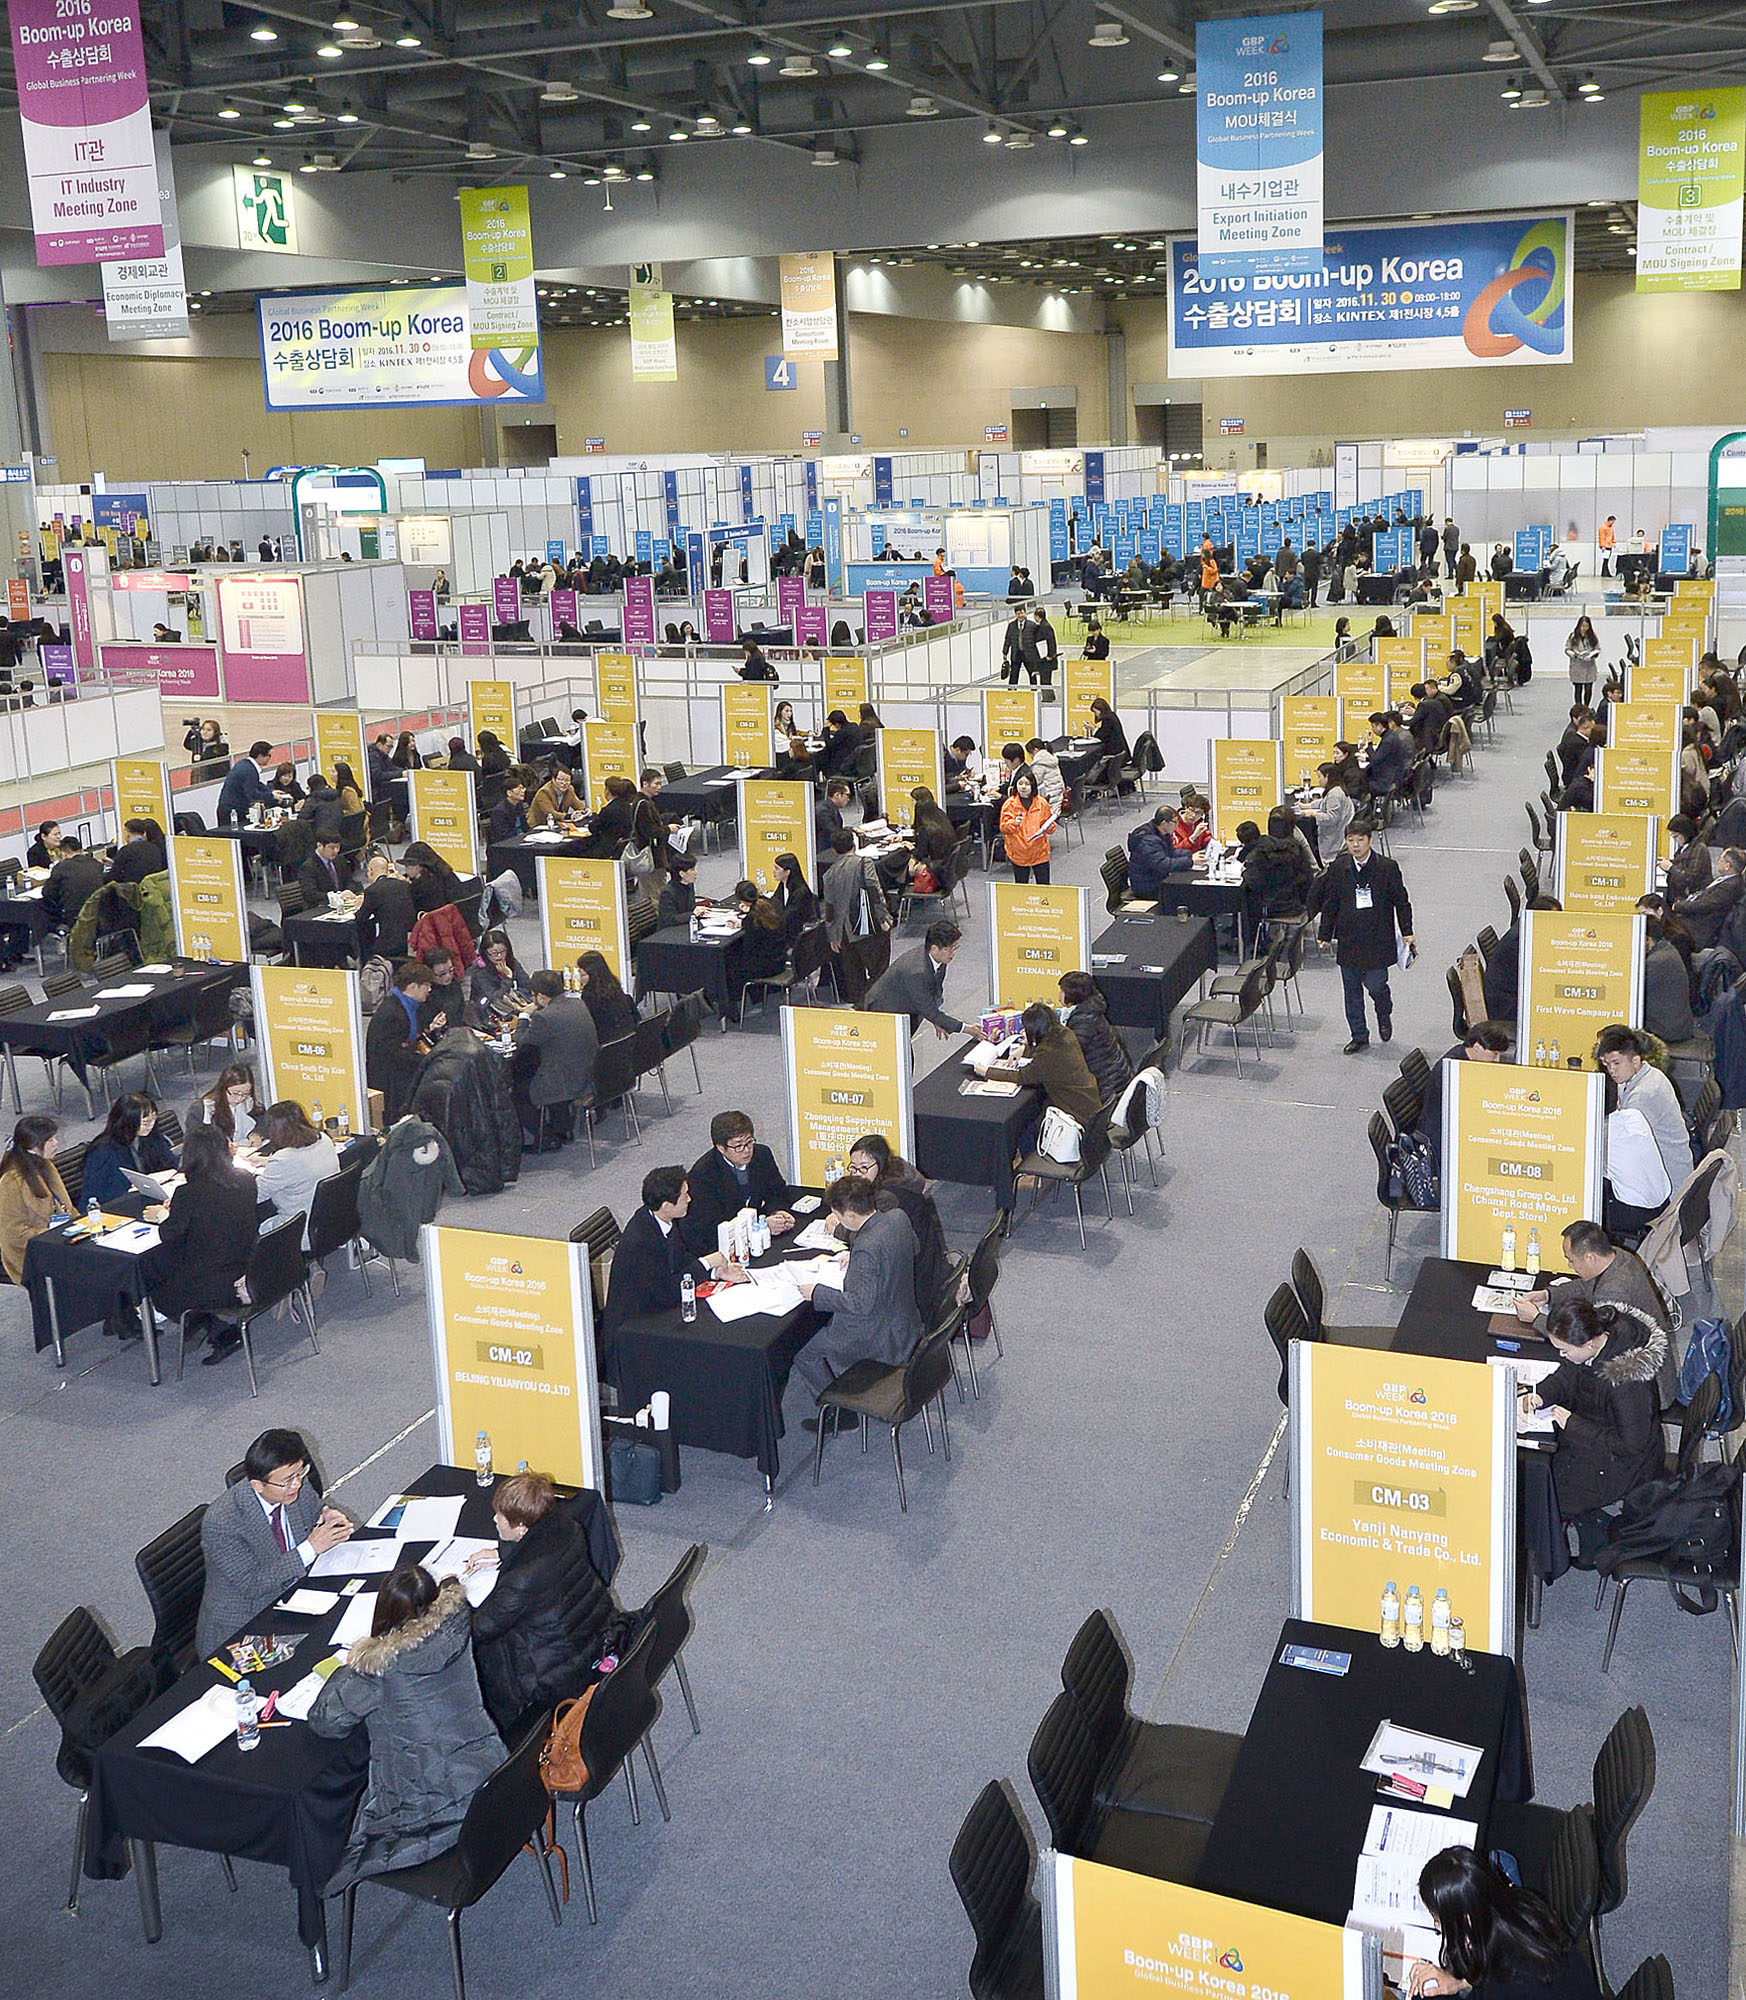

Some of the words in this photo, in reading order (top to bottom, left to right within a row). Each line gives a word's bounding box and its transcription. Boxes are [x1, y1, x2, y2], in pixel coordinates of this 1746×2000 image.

[56, 0, 91, 18] 2016
[19, 22, 85, 45] Boom-up
[88, 16, 132, 36] Korea
[1242, 36, 1265, 46] GBP
[47, 44, 112, 70] 수출상담회
[1236, 46, 1264, 56] WEEK
[26, 80, 49, 91] Global
[50, 76, 80, 88] Business
[81, 72, 117, 85] Partnering
[117, 70, 136, 81] Week
[1244, 71, 1278, 87] 2016
[1207, 92, 1270, 107] Boom-up
[1273, 87, 1316, 102] Korea
[1225, 110, 1297, 128] MOU체결식
[1678, 129, 1707, 142] 2016
[74, 139, 105, 162] IT관
[1647, 144, 1698, 157] Boom-up
[1702, 141, 1738, 152] Korea
[1666, 157, 1719, 172] 수출상담회
[60, 180, 73, 195] IT
[76, 178, 126, 194] Industry
[1221, 179, 1299, 200] 내수기업관
[1685, 189, 1695, 202] 3
[53, 200, 105, 218] Meeting
[107, 198, 138, 213] Zone
[1213, 212, 1251, 227] Export
[1254, 209, 1308, 222] Initiation
[1220, 228, 1268, 242] Meeting
[1272, 226, 1301, 238] Zone
[1665, 245, 1707, 256] Contract
[118, 263, 168, 280] 경제외교관
[1382, 257, 1463, 284] Korea
[1642, 259, 1668, 269] MOU
[1670, 257, 1708, 271] Signing
[1711, 257, 1735, 266] Zone
[496, 268, 502, 277] 2
[106, 292, 143, 302] Economic
[144, 290, 184, 302] Diplomacy
[1313, 298, 1332, 309] 일자
[1382, 292, 1396, 305] 30
[121, 304, 152, 315] Meeting
[154, 303, 172, 312] Zone
[1183, 298, 1301, 330] 수출상담회
[1313, 314, 1332, 324] 장소
[1336, 311, 1386, 323] KINTEX
[1389, 308, 1433, 320] 제1전시장
[270, 320, 313, 342] 2016
[319, 318, 401, 342] Boom-up
[408, 314, 464, 335] Korea
[473, 322, 490, 330] MOU
[273, 348, 354, 372] 수출상담회
[380, 359, 413, 367] KINTEX
[773, 360, 790, 386] 4
[1592, 877, 1619, 887] CM-18
[1026, 950, 1053, 960] CM-12
[1564, 988, 1597, 999] CM-13
[1536, 1006, 1552, 1014] First
[1554, 1006, 1575, 1015] Wave
[1577, 1008, 1611, 1018] Company
[830, 1092, 864, 1105] CM-07
[810, 1122, 859, 1135] Management
[1500, 1163, 1542, 1178] CM-08
[1517, 1189, 1542, 1202] Group
[1510, 1200, 1534, 1210] Road
[1492, 1208, 1516, 1220] Dept.
[1518, 1211, 1548, 1223] Store)
[465, 1272, 500, 1285] Boom-up
[501, 1277, 525, 1288] Korea
[527, 1280, 546, 1290] 2016
[490, 1318, 513, 1329] Goods
[514, 1322, 544, 1334] Meeting
[545, 1325, 564, 1335] Zone
[489, 1346, 533, 1366] CM-02
[455, 1372, 489, 1385] BEIJING
[1383, 1383, 1406, 1393] GBP
[1376, 1391, 1405, 1402] WEEK
[1345, 1400, 1392, 1417] Boom-up
[1396, 1407, 1427, 1420] Korea
[1431, 1411, 1457, 1424] 2016
[1326, 1446, 1374, 1462] Consumer
[1376, 1455, 1406, 1468] Goods
[1409, 1459, 1450, 1476] Meeting
[1452, 1465, 1477, 1478] Zone
[1372, 1486, 1430, 1511] CM-03
[1352, 1518, 1386, 1535] Yanji
[1390, 1524, 1448, 1548] Nanyang
[1320, 1528, 1379, 1548] Economic
[1382, 1538, 1392, 1551] &
[1395, 1540, 1431, 1557] Trade
[1434, 1547, 1457, 1562] Co.,
[1460, 1550, 1482, 1566] Ltd.
[1179, 1933, 1213, 1949] GBP
[1168, 1941, 1212, 1965] WEEK
[1124, 1949, 1194, 1983] Boom-up
[1198, 1969, 1245, 1997] Korea
